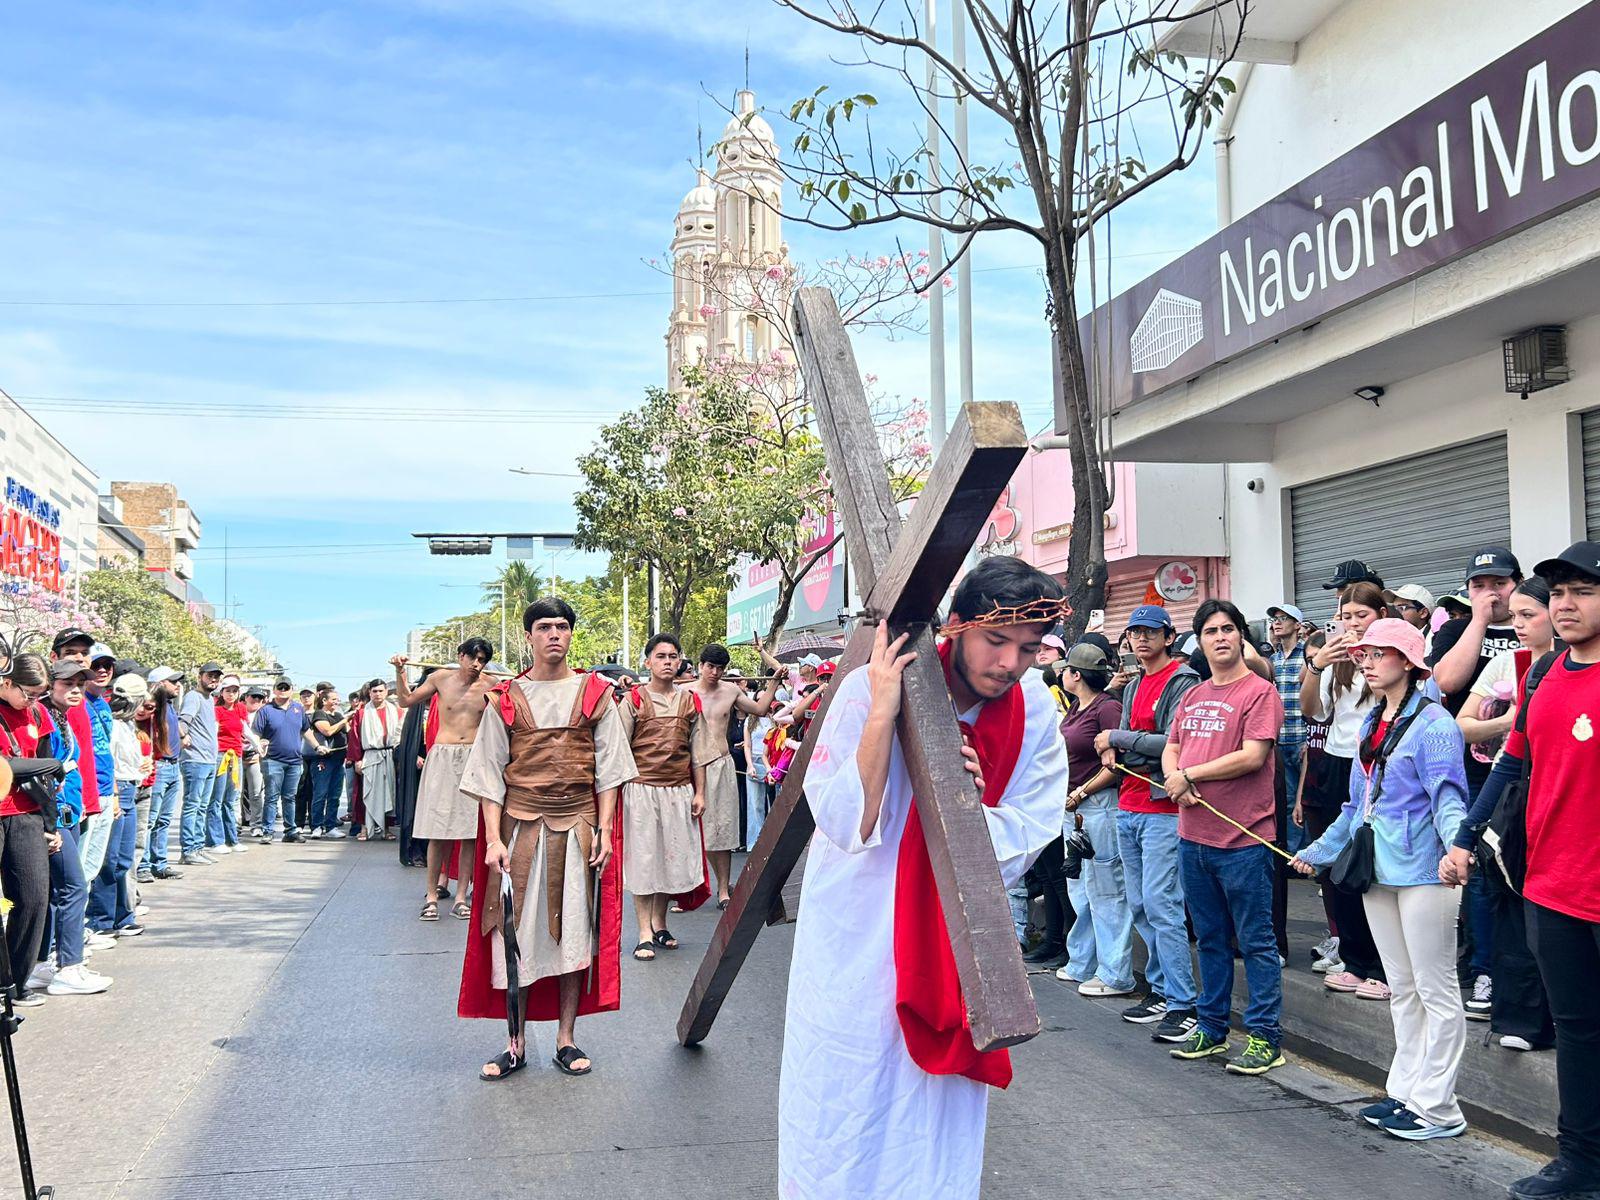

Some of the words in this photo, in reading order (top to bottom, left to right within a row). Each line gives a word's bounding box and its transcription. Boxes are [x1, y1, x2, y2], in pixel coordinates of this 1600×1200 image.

[1219, 120, 1455, 336] Nacional
[1470, 60, 1600, 213] Mo
[1475, 553, 1497, 566] CAT
[1181, 718, 1198, 730] LAS
